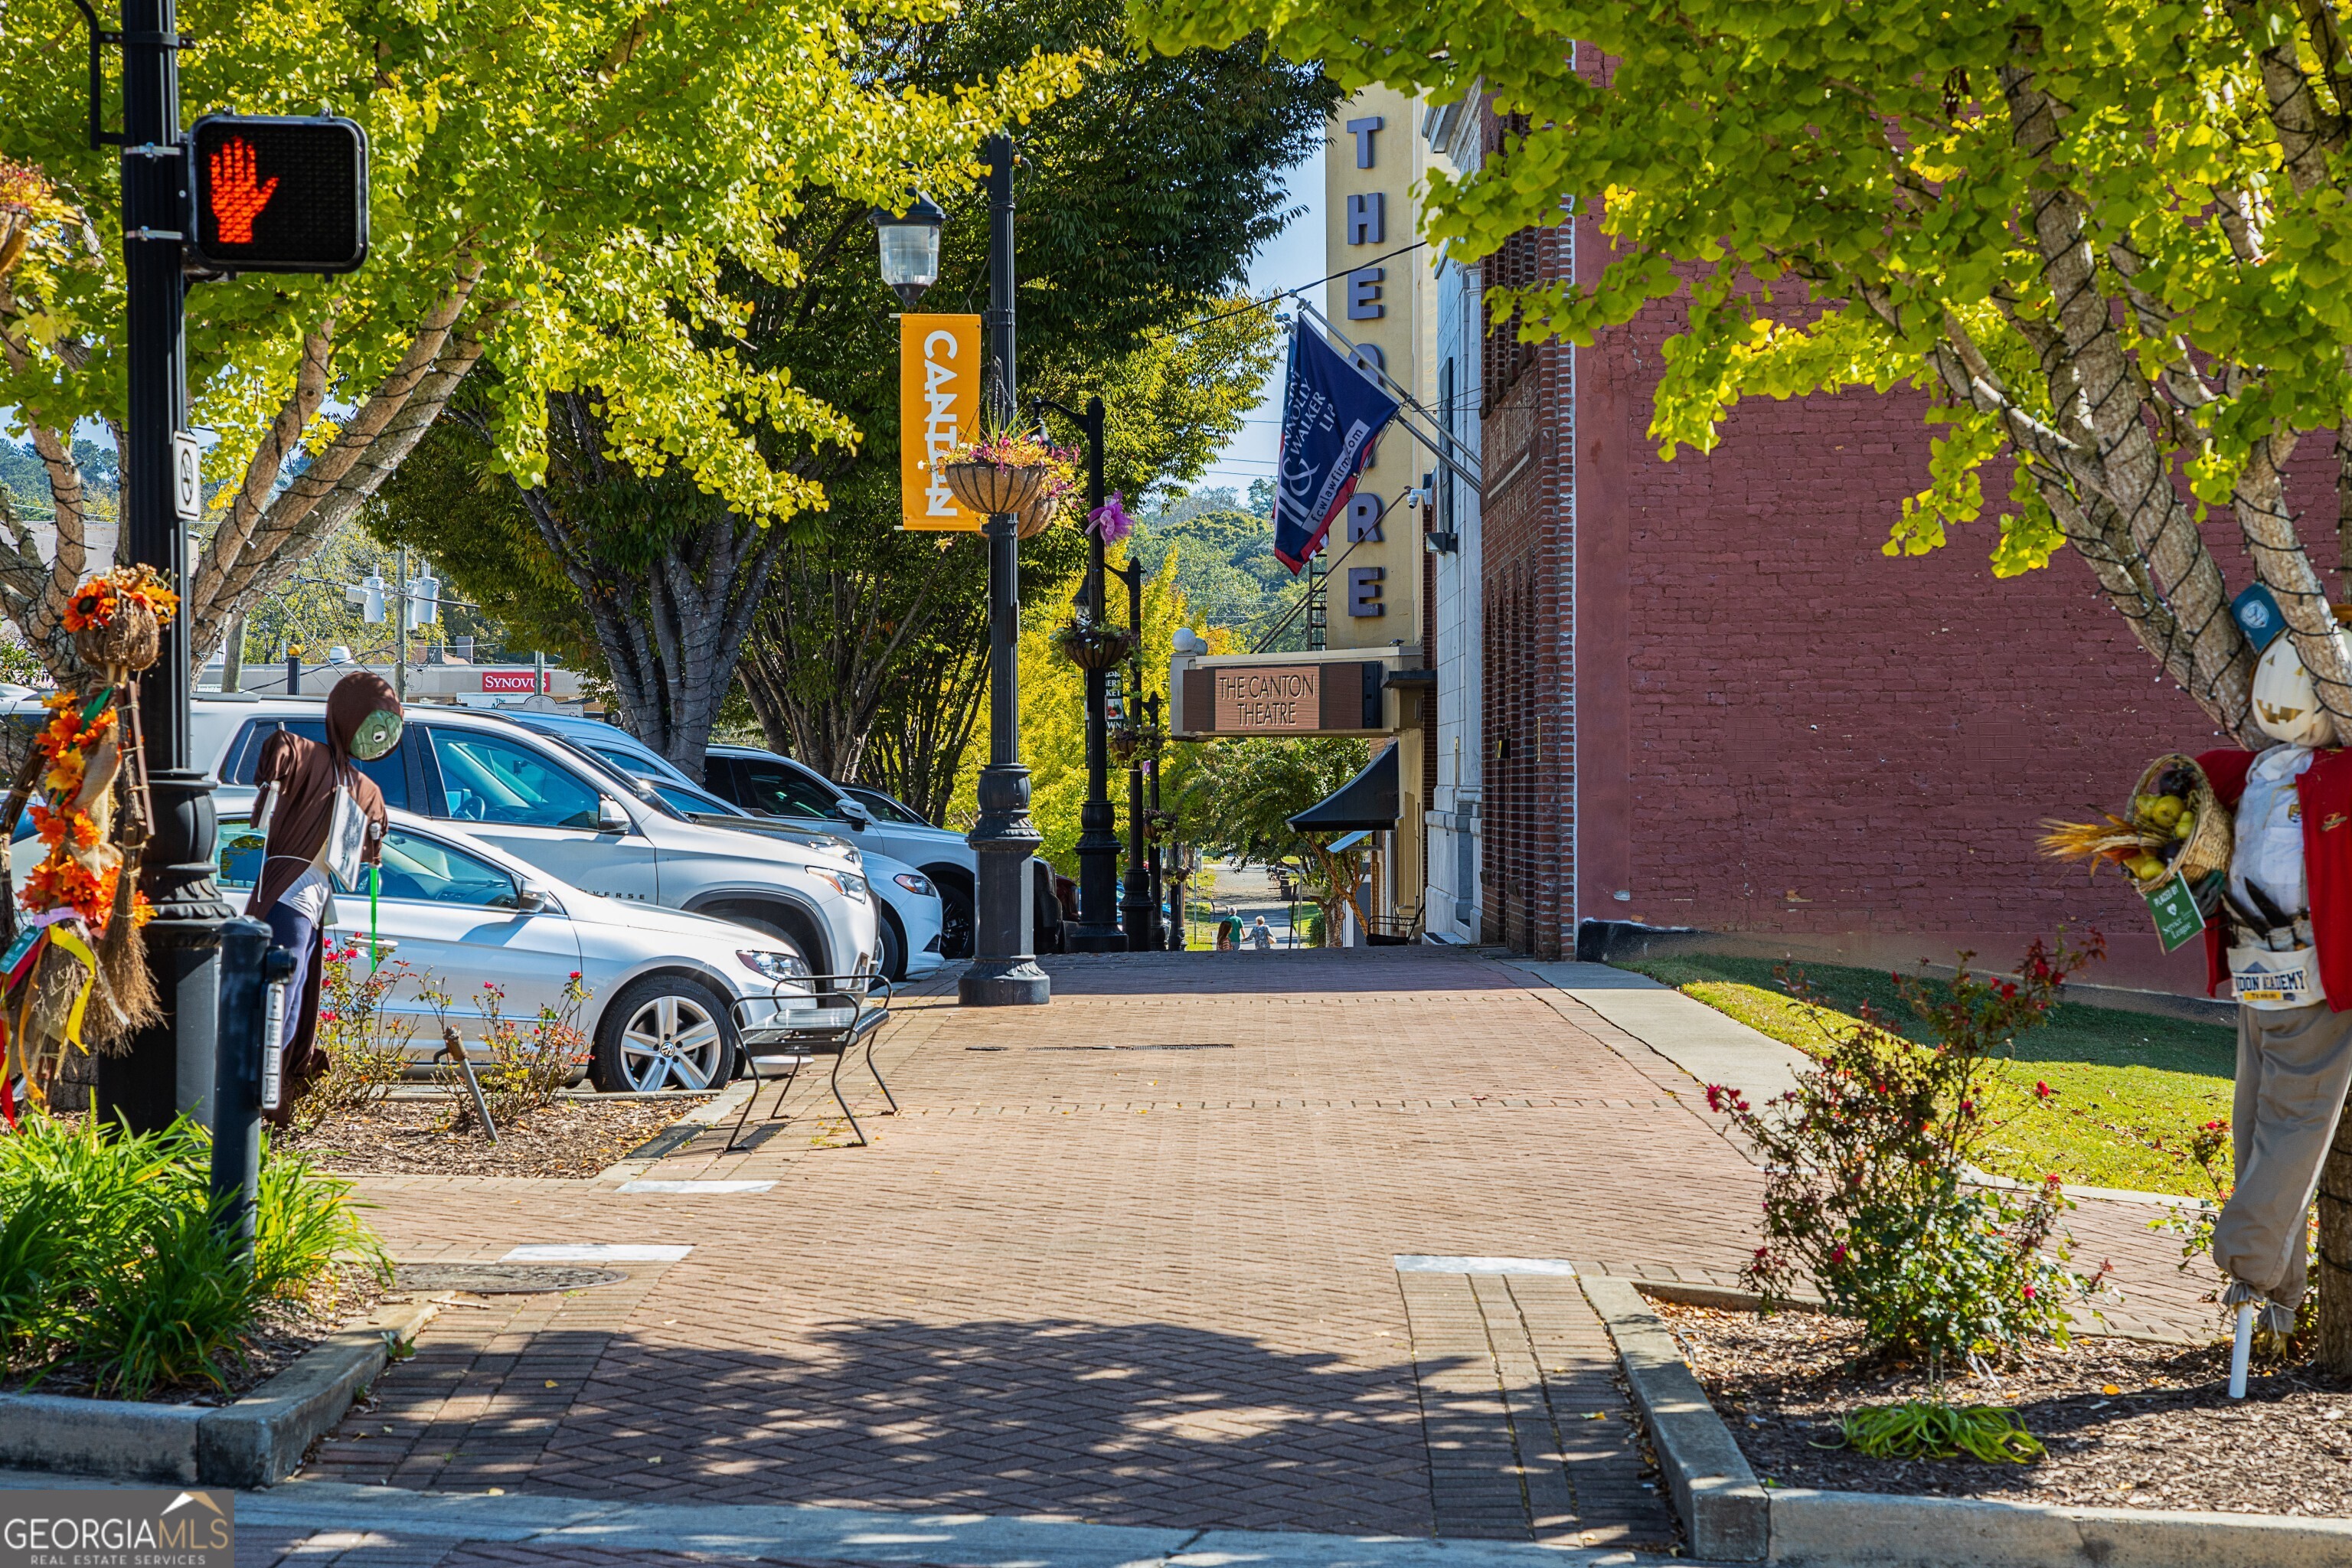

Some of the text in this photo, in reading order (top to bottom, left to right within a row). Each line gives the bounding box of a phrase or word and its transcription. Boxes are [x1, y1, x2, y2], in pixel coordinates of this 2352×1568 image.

[1347, 116, 1384, 617] THEARE
[1290, 391, 1326, 455] WALKER
[1312, 430, 1364, 524] fcwlawfirm.com
[1220, 675, 1315, 700] THE CANTON
[1237, 701, 1297, 727] THEATRE
[2152, 890, 2173, 907] PLACED
[2262, 970, 2305, 991] ACADEMY
